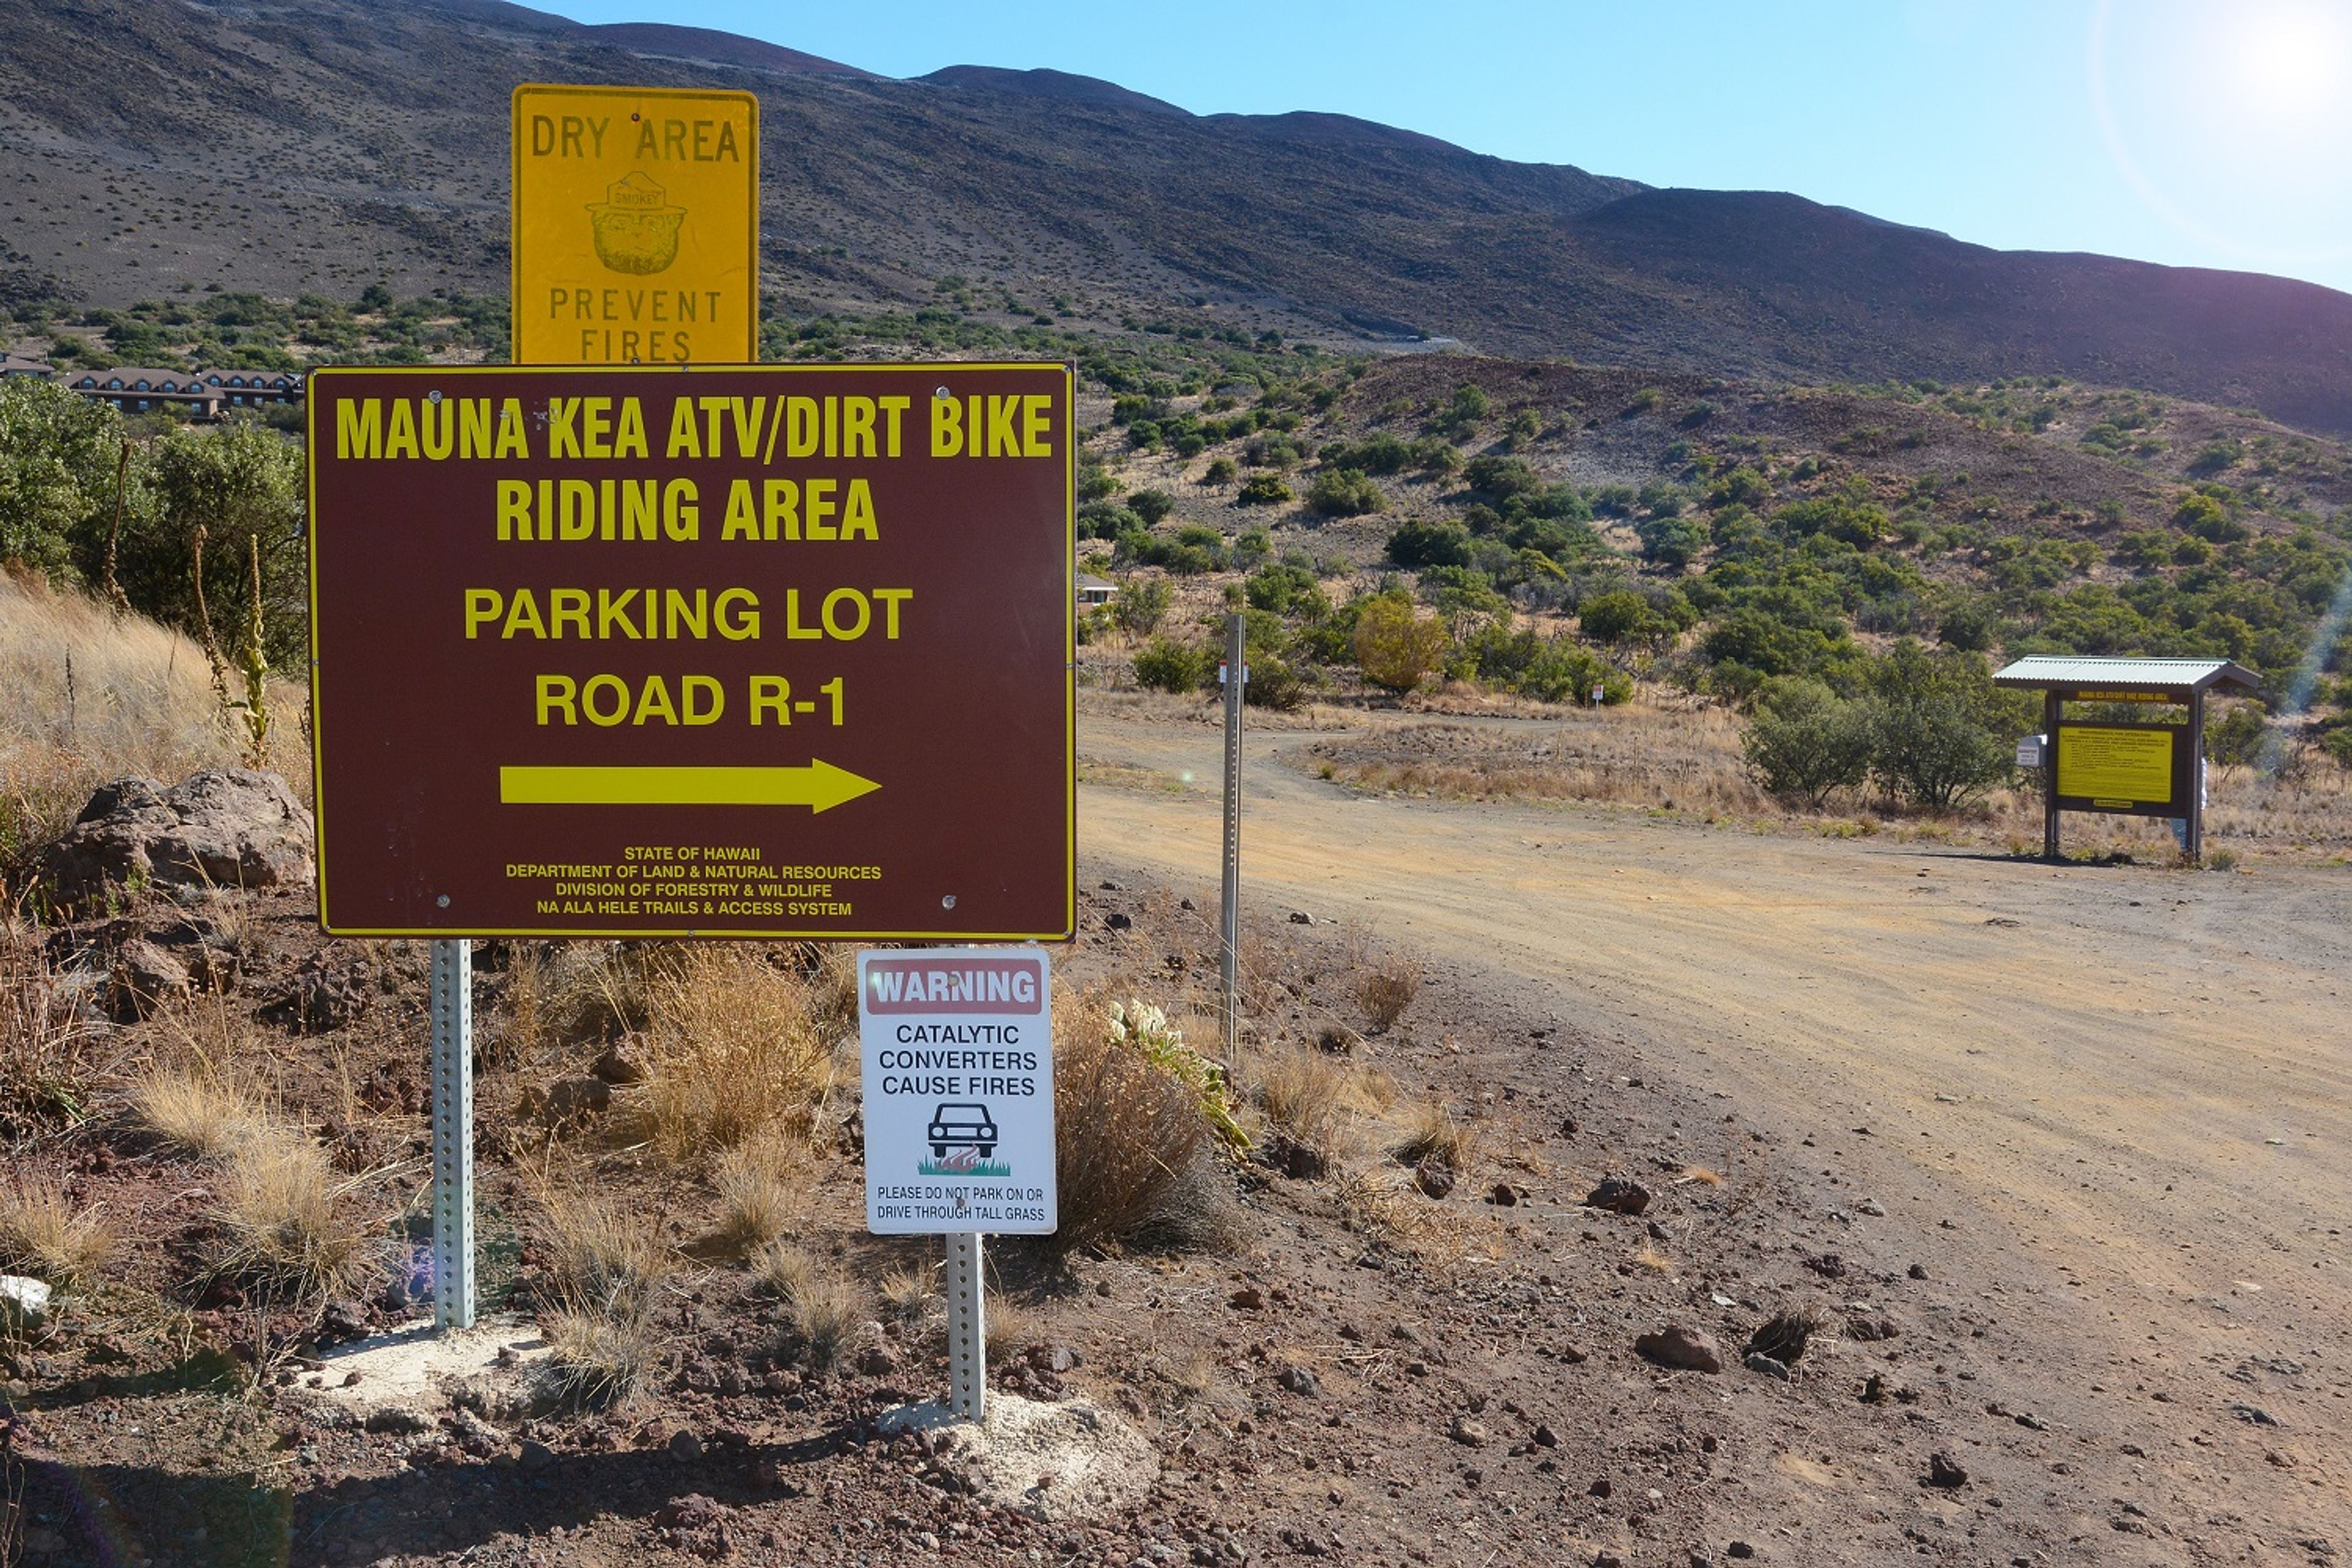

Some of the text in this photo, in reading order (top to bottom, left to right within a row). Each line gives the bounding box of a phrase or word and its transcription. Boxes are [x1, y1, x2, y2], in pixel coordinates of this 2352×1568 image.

[532, 115, 739, 162] DRY AREA
[615, 192, 662, 205] SMOKEY
[550, 288, 720, 322] PREVENT
[582, 330, 690, 361] FIRES
[336, 394, 1052, 465] MAUNA KEA ATV/DIRT BIKE
[497, 478, 879, 542] RIDING AREA
[464, 587, 914, 641] PARKING LOT
[536, 674, 843, 727] ROAD R-1
[624, 846, 760, 861] STATE OF HAWAII
[506, 864, 882, 879] DEPARTMENT OF LAND & NATURAL RESOURCES
[556, 883, 832, 898] DIVISION OF FORESTRY & WILDLIFE
[537, 901, 852, 916] NA ALA HELE TRAILS & ACCESS SYSTEM
[875, 971, 1035, 1003] WARNING
[897, 1025, 1018, 1044] CATALYTIC
[880, 1051, 1036, 1070] CONVERTERS
[883, 1076, 1034, 1096] CAUSE FIRES
[878, 1187, 1042, 1200] PLEASE DO NOT PARK ON OR
[878, 1205, 1044, 1220] DRIVE THROUGH TALL GRASS
